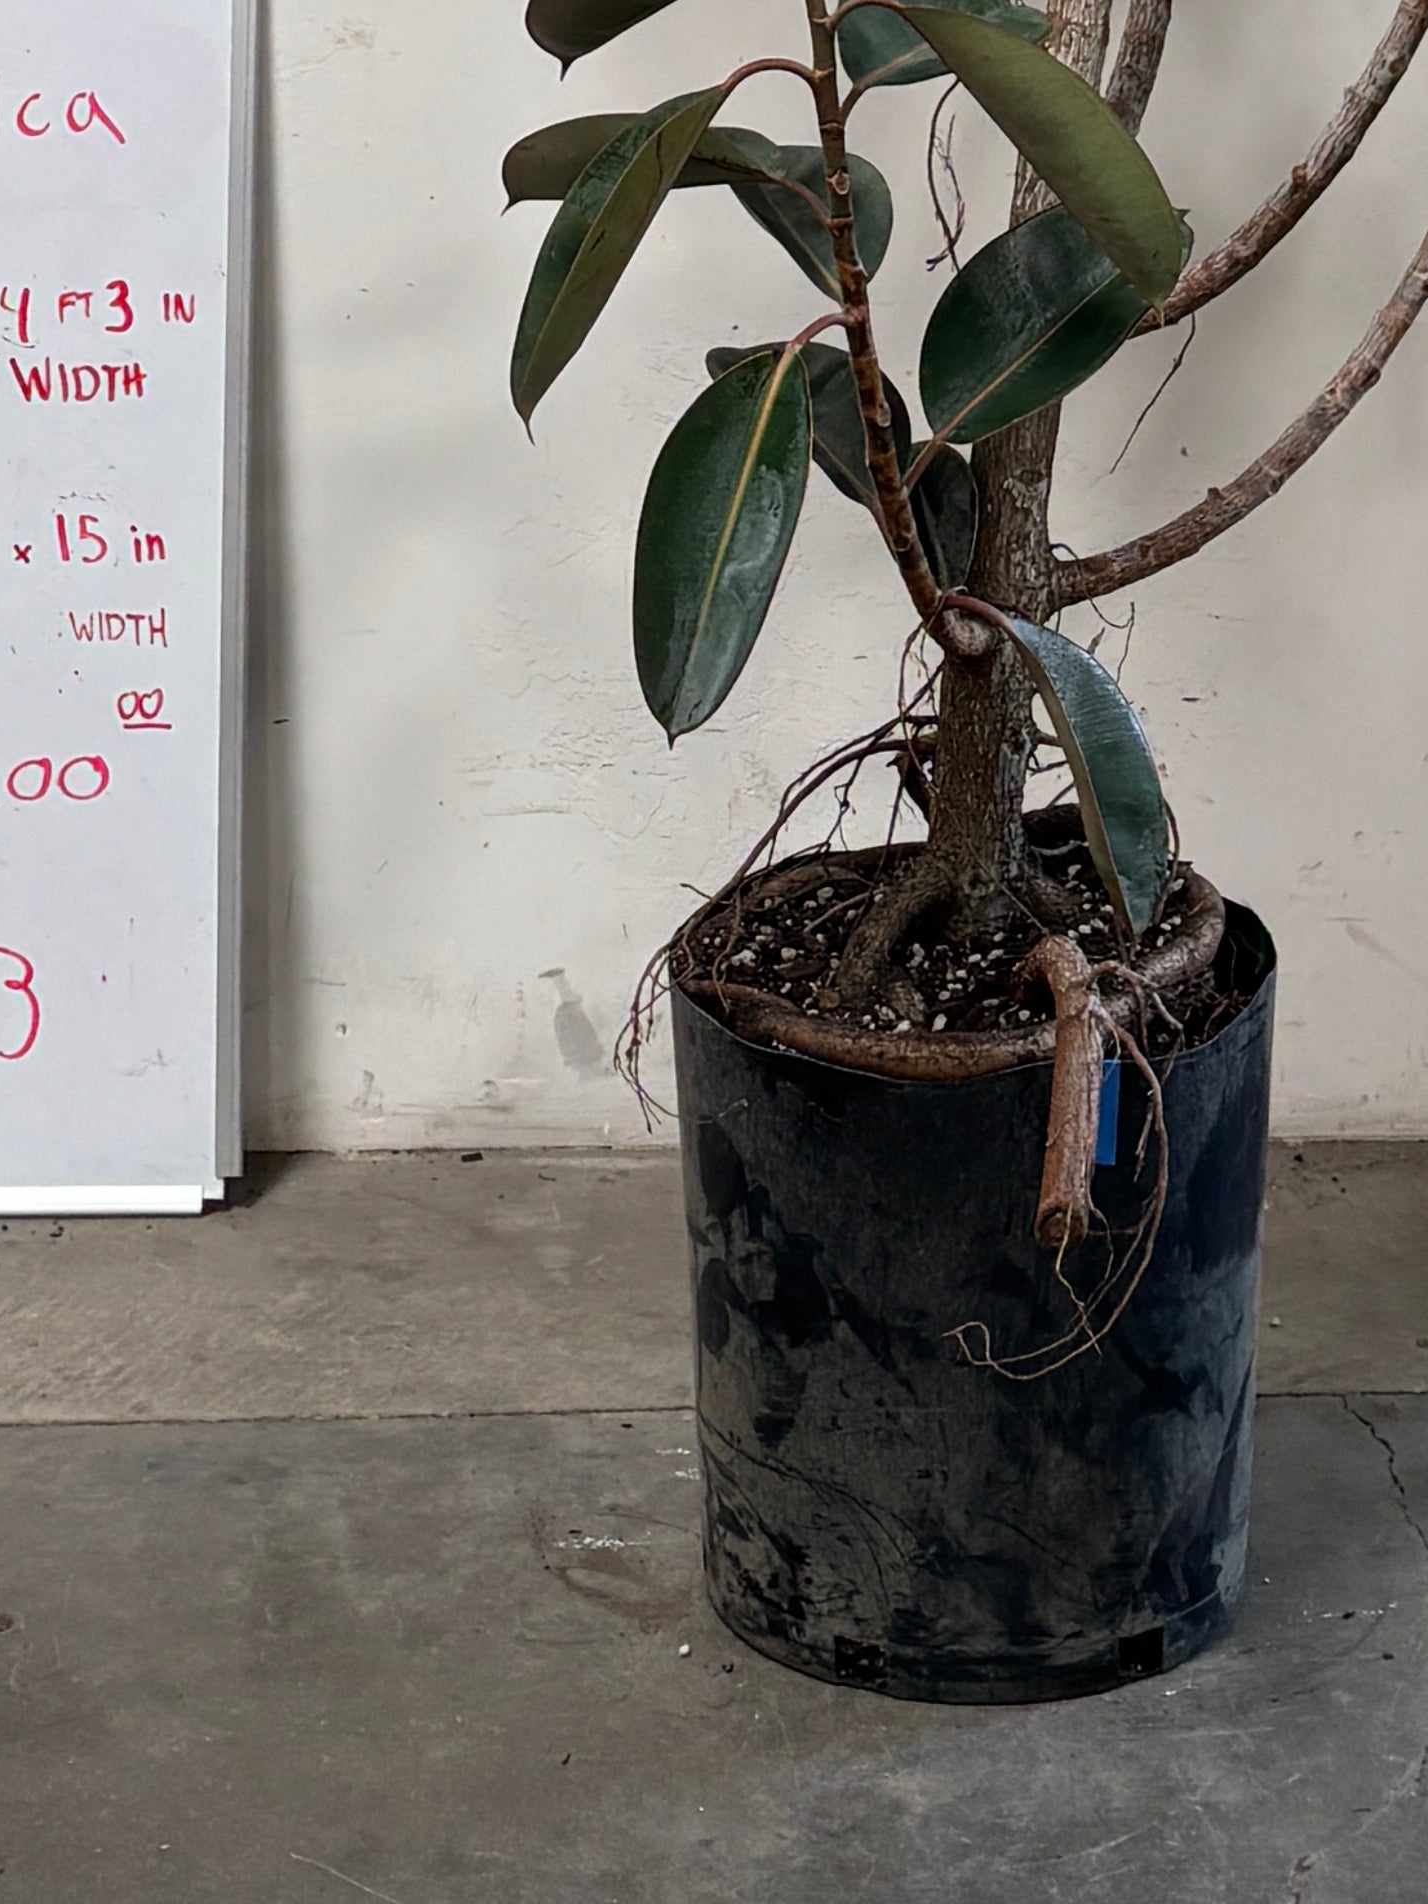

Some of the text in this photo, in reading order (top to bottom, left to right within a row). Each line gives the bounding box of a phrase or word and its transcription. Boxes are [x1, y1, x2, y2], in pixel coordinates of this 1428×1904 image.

[57, 291, 93, 324] FT
[105, 279, 134, 334] 3
[162, 292, 195, 325] IN
[8, 356, 147, 403] WIDTH
[55, 513, 108, 564] 15
[129, 524, 167, 564] in
[68, 607, 169, 648] WIDTH
